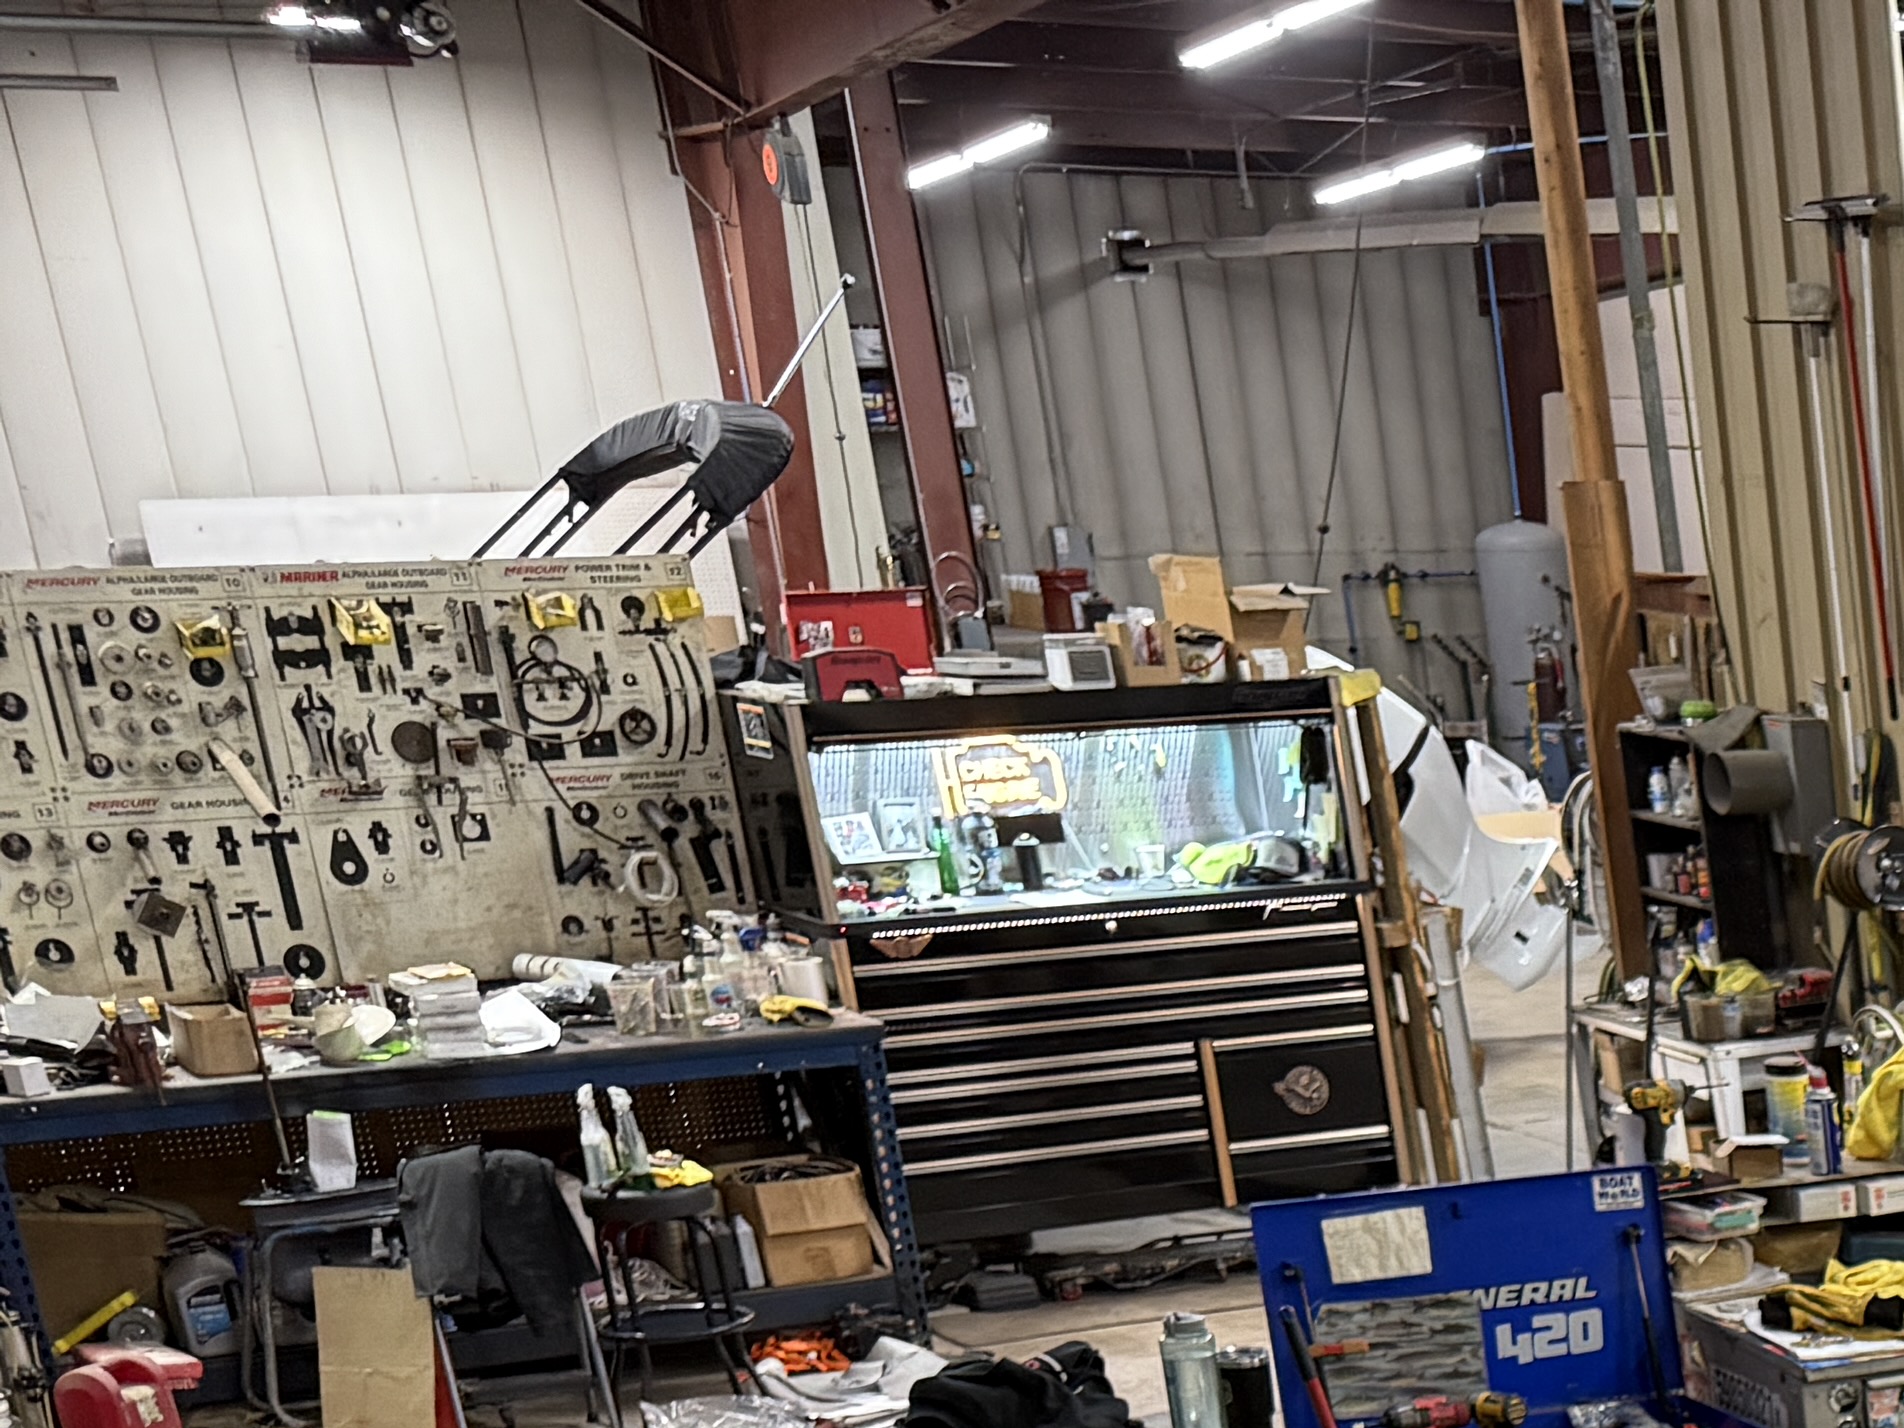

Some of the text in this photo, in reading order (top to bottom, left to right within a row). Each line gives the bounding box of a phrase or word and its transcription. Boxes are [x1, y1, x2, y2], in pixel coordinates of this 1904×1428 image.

[1599, 1175, 1634, 1189] BOAT
[1458, 1276, 1598, 1311] NERAL
[1495, 1307, 1604, 1365] 420
